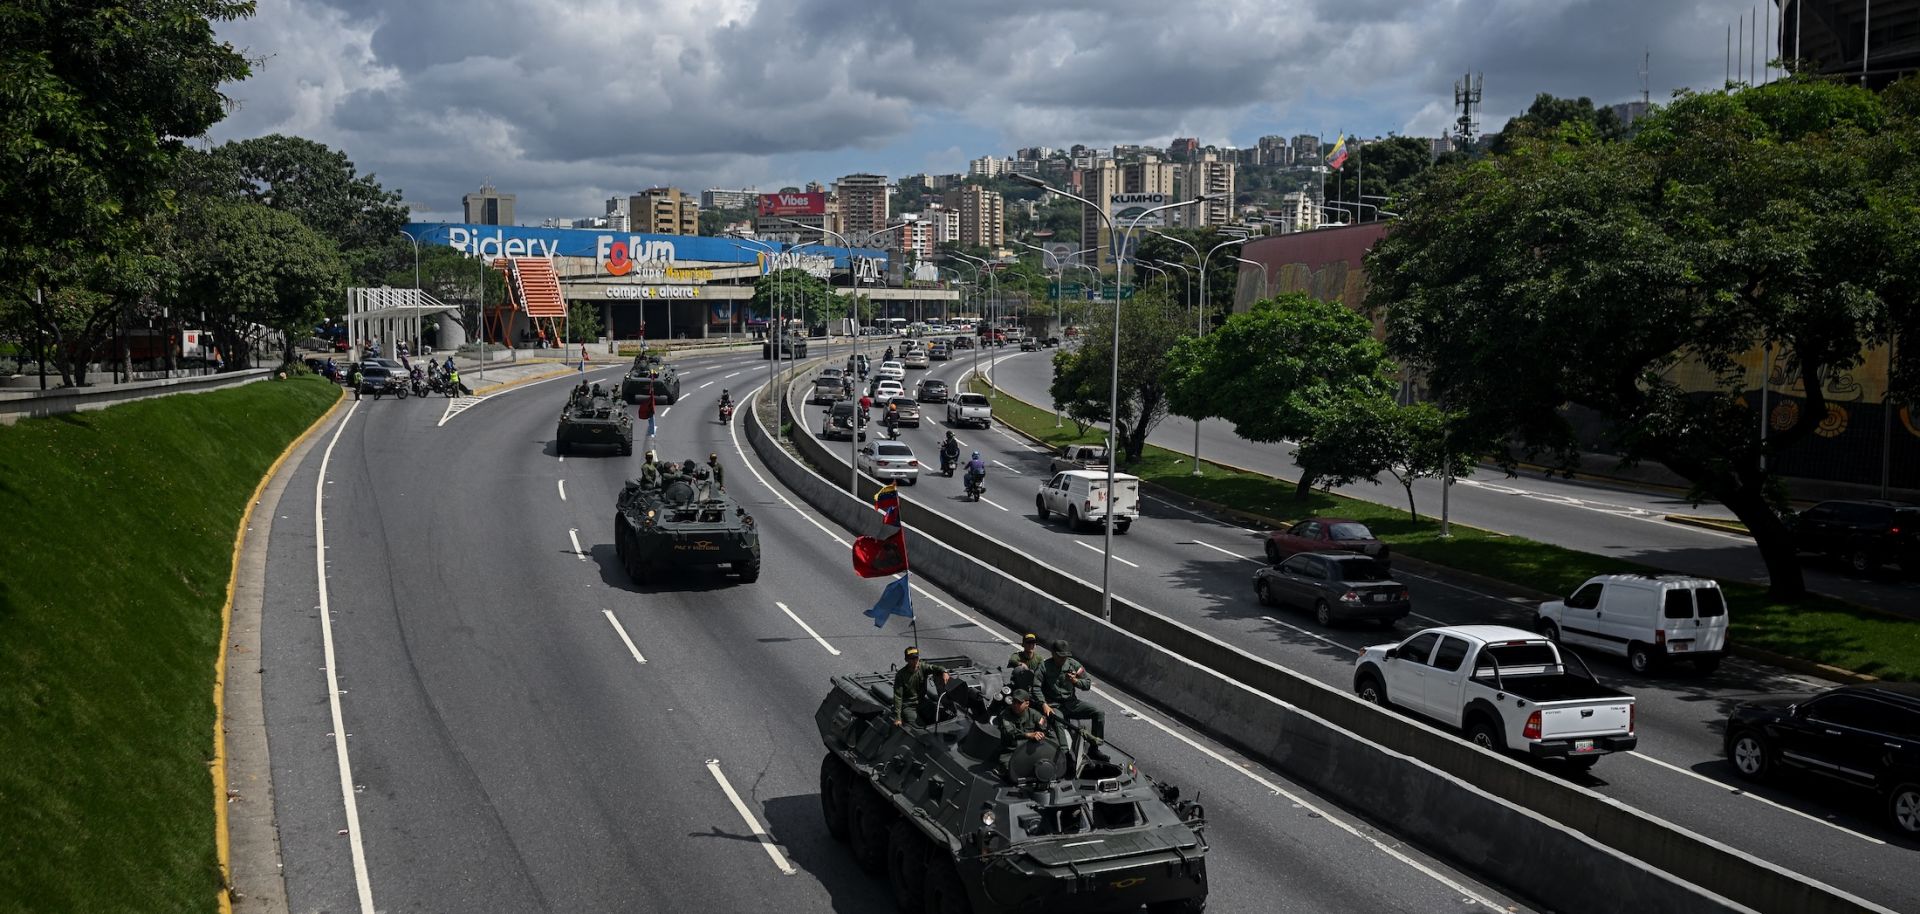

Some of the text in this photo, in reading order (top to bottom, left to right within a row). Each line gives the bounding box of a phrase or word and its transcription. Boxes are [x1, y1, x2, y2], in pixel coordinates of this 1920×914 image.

[779, 194, 808, 206] Vibes
[1111, 194, 1163, 203] KUMHO
[449, 227, 559, 262] Ridery
[597, 234, 675, 266] Forum
